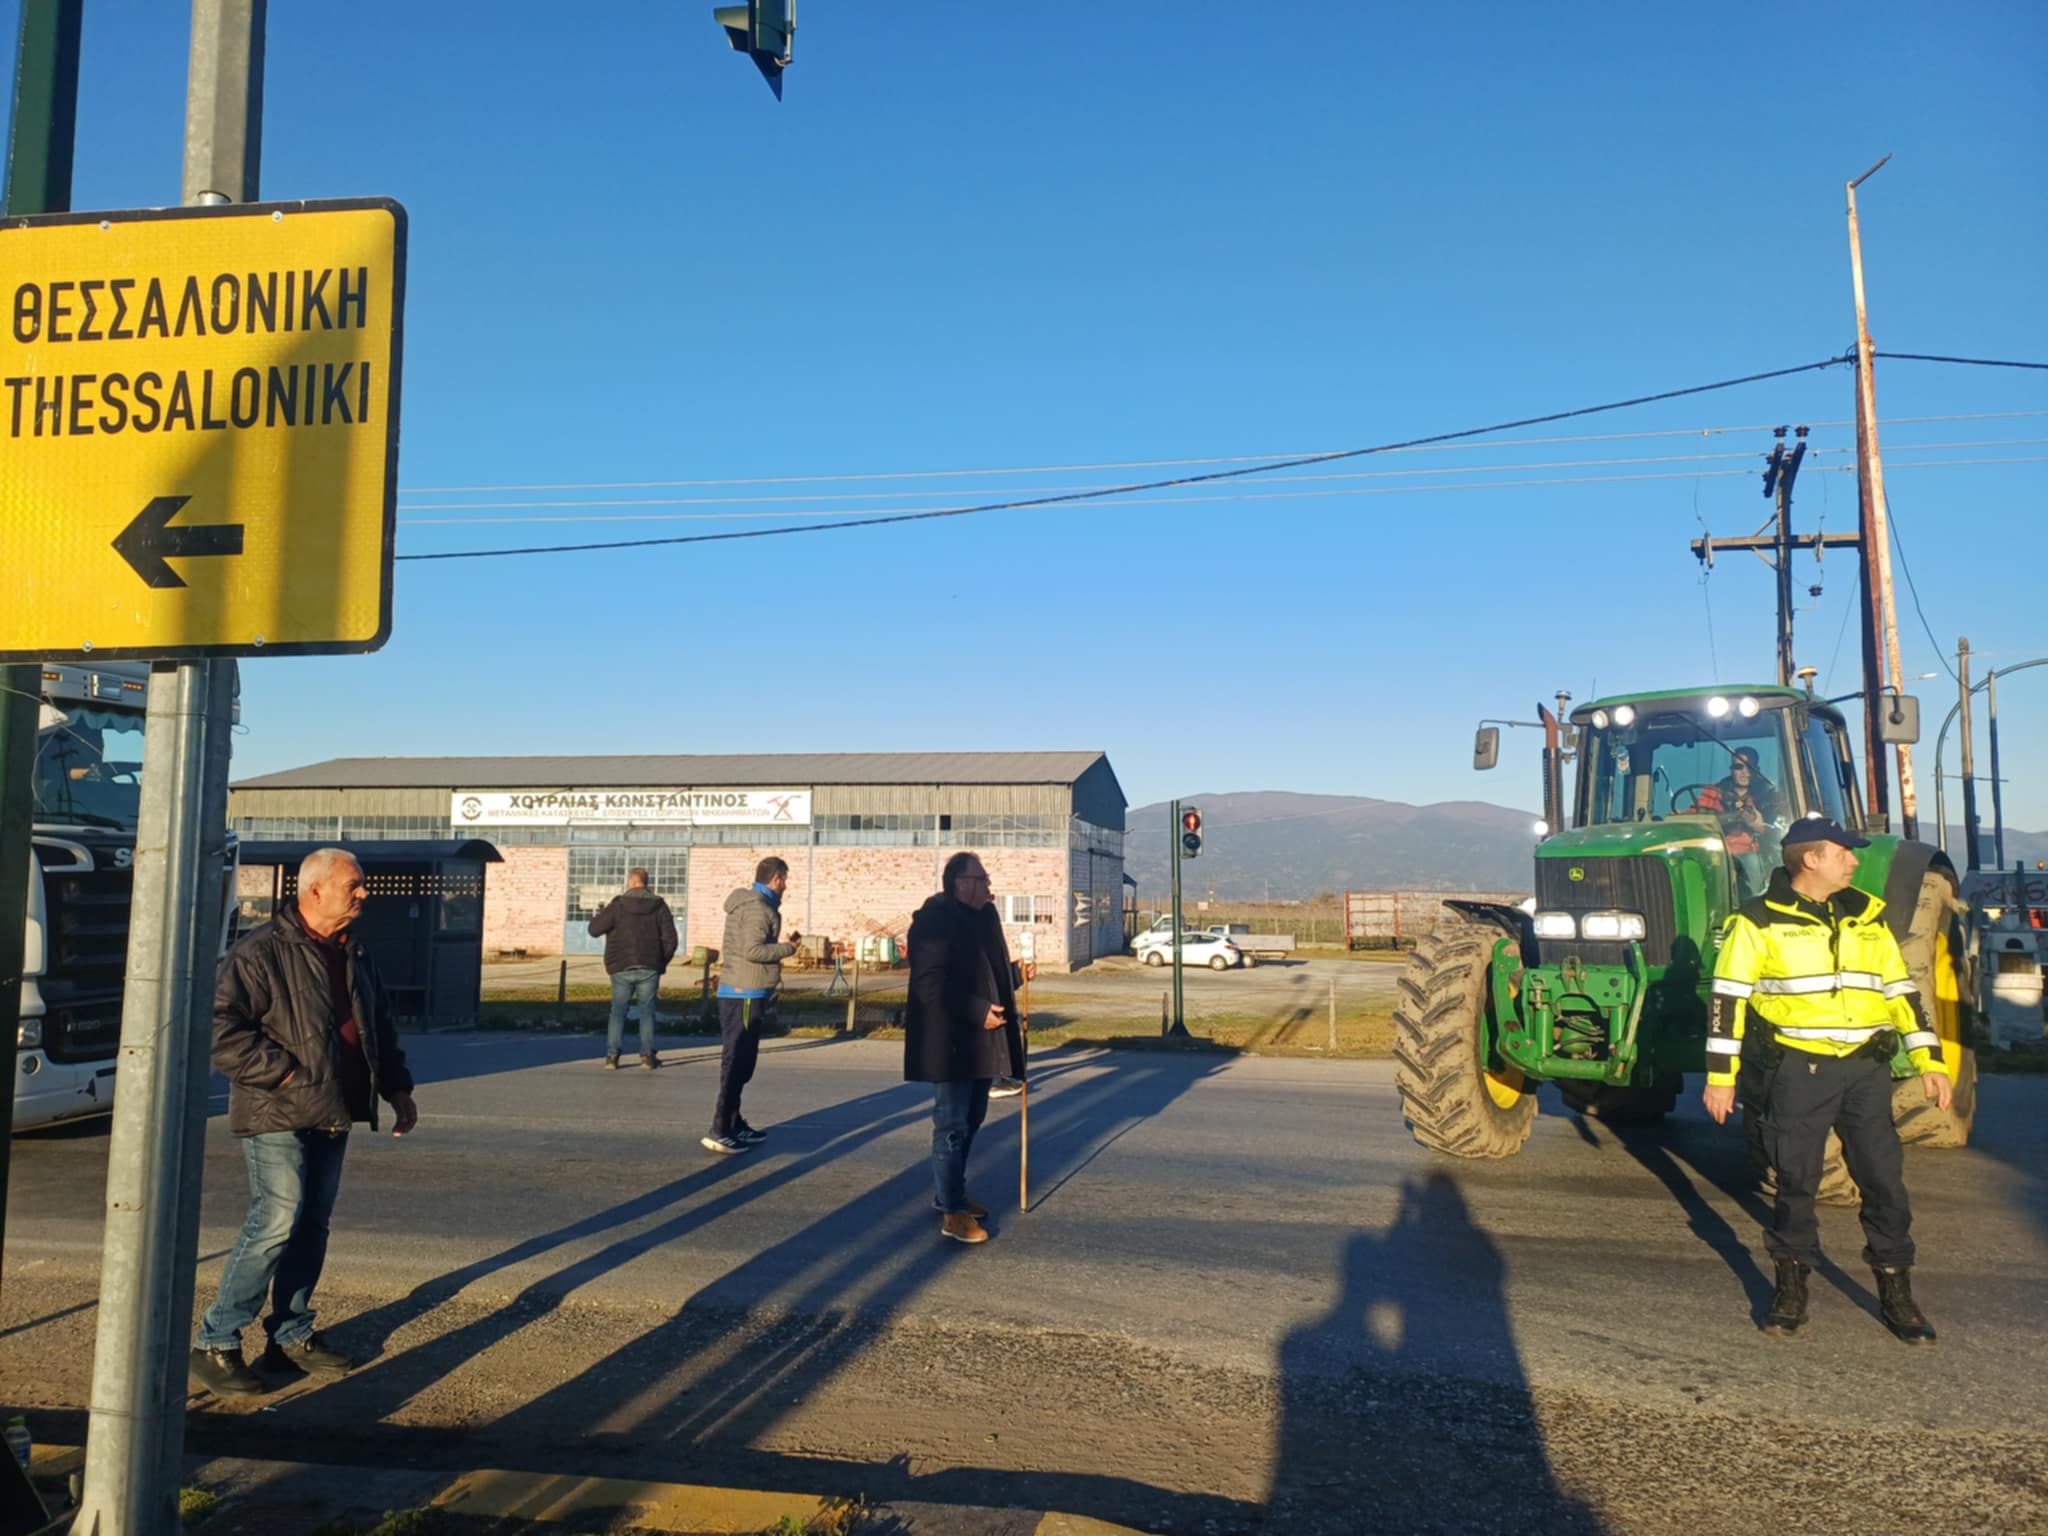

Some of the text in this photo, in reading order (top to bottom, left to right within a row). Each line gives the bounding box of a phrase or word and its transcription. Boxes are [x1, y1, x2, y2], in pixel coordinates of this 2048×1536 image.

[13, 266, 368, 343] ΘΕΣΣΑΛΟΝΙΚΗ
[5, 361, 370, 438] THESSALONIKI
[605, 794, 748, 808] ΚΩΝΣΤΑΝΤΙΝΟΣ
[1712, 998, 1722, 1033] POLICE
